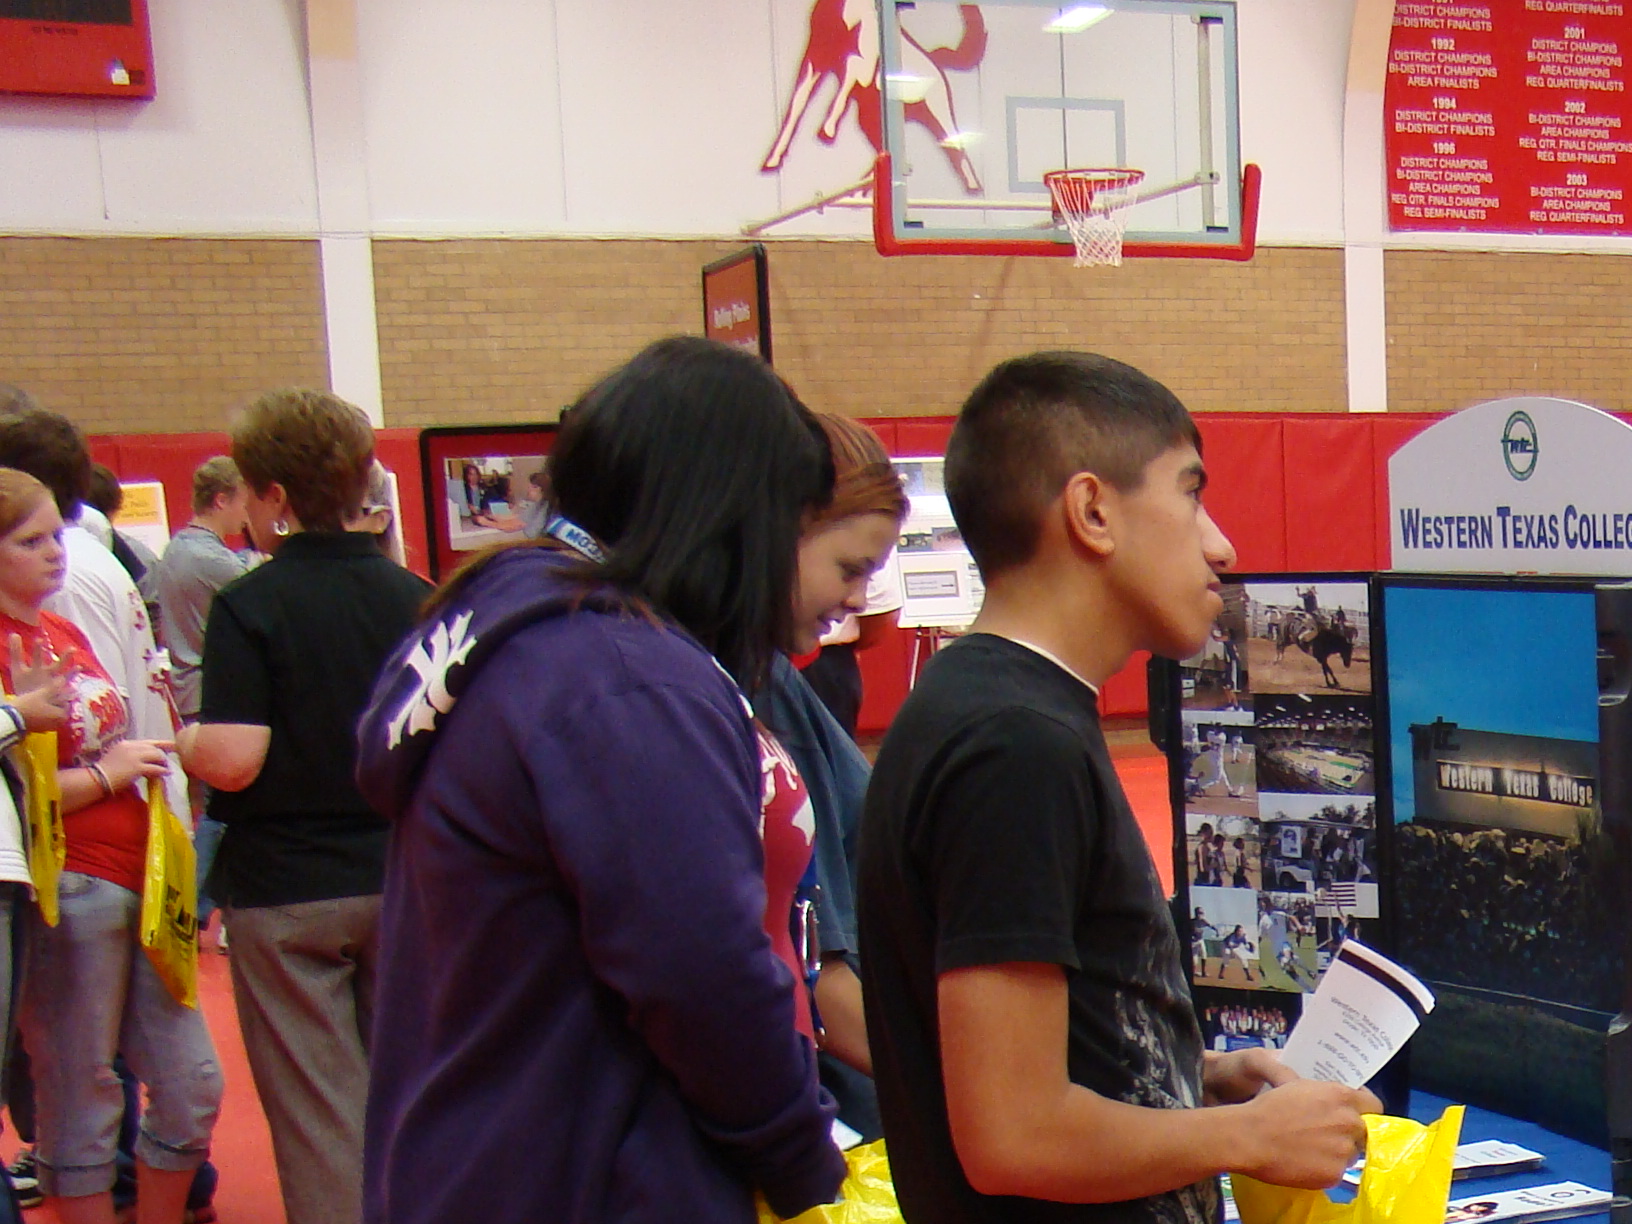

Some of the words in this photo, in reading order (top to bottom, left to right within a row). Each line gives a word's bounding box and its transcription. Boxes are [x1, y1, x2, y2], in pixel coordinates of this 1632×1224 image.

[1437, 7, 1490, 18] CHAMPIONS
[1447, 19, 1492, 31] FINALISTS
[1431, 37, 1455, 51] 1992
[1532, 39, 1568, 50] DISTRICT
[1570, 41, 1617, 54] CHAMPIONS
[1395, 50, 1436, 62] DISTRICT
[1438, 53, 1491, 65] CHAMPIONS
[1528, 51, 1572, 62] BI-DISTRICT
[1575, 54, 1622, 67] CHAMPIONS
[1389, 63, 1442, 74] BI-DISTRICT
[1444, 66, 1497, 78] CHAMPIONS
[1540, 65, 1561, 75] AREA
[1563, 66, 1610, 78] CHAMPIONS
[1408, 76, 1433, 86] AREA
[1435, 78, 1479, 89] FINALISTS
[1433, 96, 1456, 109] 1994
[1396, 110, 1436, 121] DISTRICT
[1439, 112, 1492, 124] CHAMPIONS
[1529, 113, 1573, 125] BI-DISTRICT
[1575, 115, 1621, 128] CHAMPIONS
[1396, 122, 1448, 134] BI-DISTRICT
[1451, 124, 1495, 136] FINALISTS
[1541, 127, 1562, 136] AREA
[1564, 127, 1609, 139] CHAMPIONS
[1401, 157, 1438, 168] DISTRICT
[1440, 159, 1488, 170] CHAMPIONS
[1396, 168, 1442, 180] BI-DISTRICT
[1444, 171, 1493, 183] CHAMPIONS
[1409, 182, 1431, 192] AREA
[1433, 183, 1480, 195] CHAMPIONS
[1531, 186, 1574, 197] BI-DISTRICT
[1577, 188, 1622, 200] CHAMPIONS
[1543, 199, 1564, 209] AREA
[1565, 200, 1610, 211] CHAMPIONS
[1400, 508, 1494, 549] WESTERN
[1496, 506, 1559, 549] TEXAS
[1439, 763, 1493, 793] Western
[1503, 768, 1540, 798] Texas
[1548, 774, 1593, 807] College
